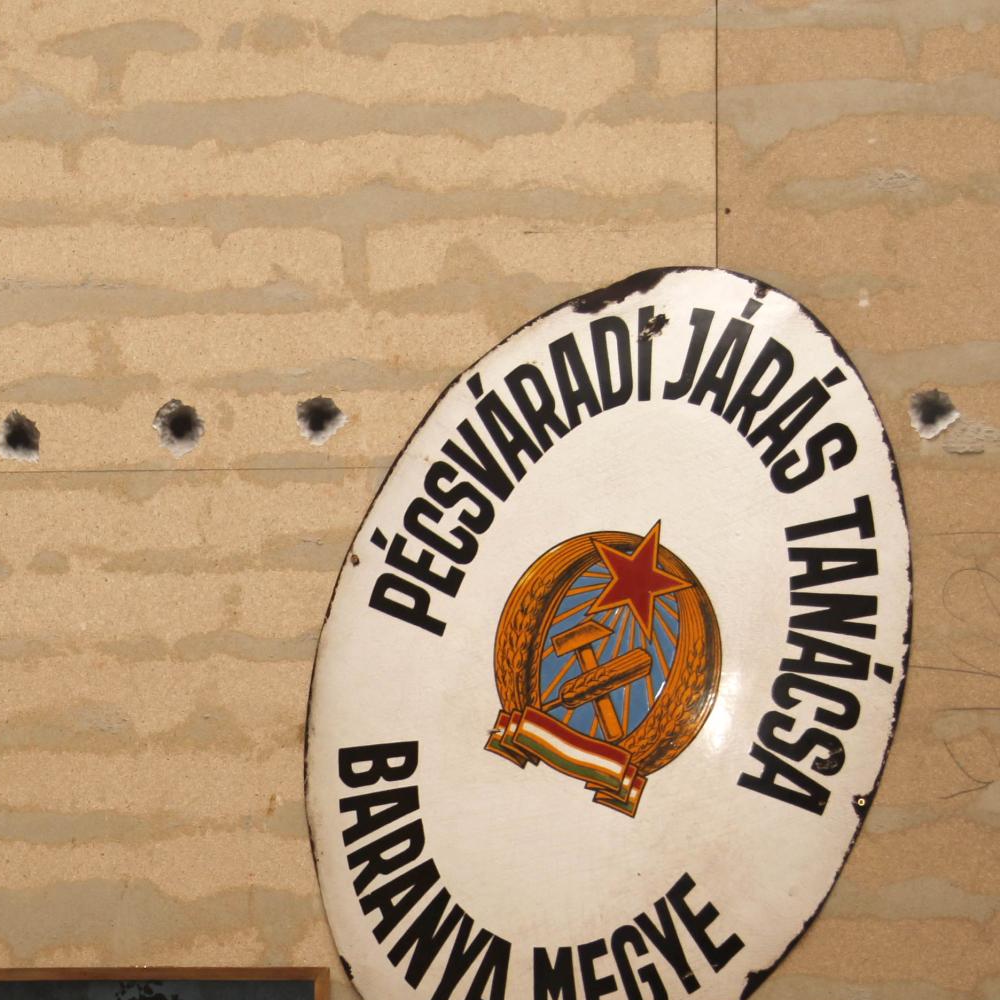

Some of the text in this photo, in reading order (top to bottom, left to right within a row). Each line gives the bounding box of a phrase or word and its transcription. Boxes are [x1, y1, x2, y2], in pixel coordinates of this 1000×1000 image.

[367, 295, 895, 818] PÉCSVÁRADI JÁRÁS TANÁCSA
